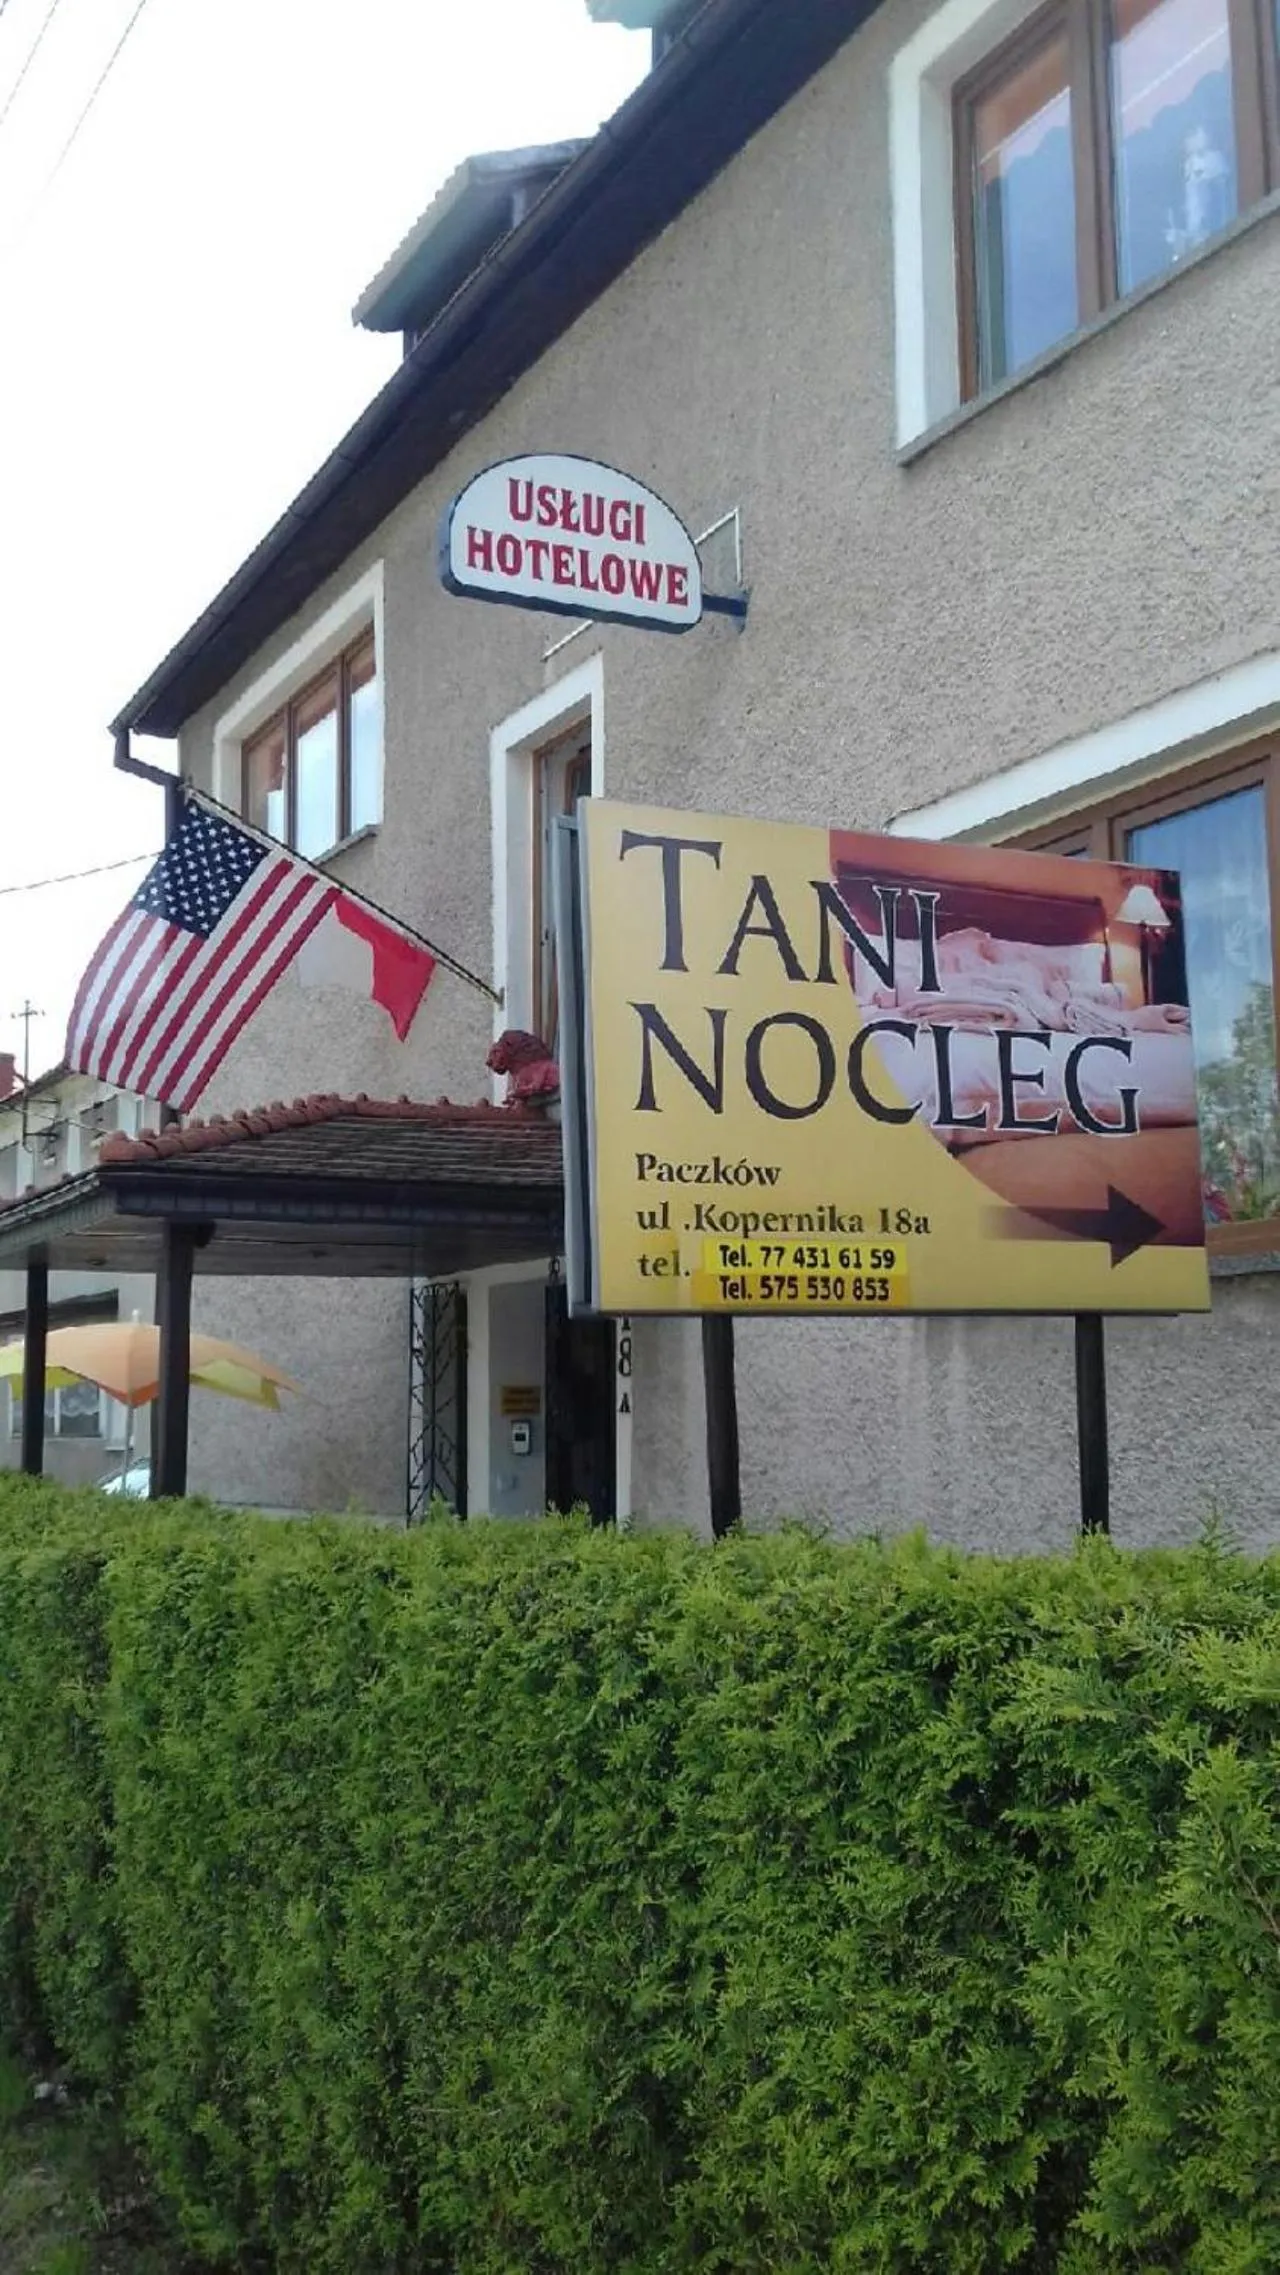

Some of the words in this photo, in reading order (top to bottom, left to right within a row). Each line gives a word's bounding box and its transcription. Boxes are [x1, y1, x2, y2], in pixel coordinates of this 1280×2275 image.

[508, 477, 646, 545] USŁUGI
[467, 525, 689, 607] HOTELOWE
[620, 829, 942, 992] TANI
[626, 1001, 1140, 1134] NOCLEG
[635, 1153, 781, 1186] Paczków
[879, 1207, 931, 1235] 18a
[637, 1249, 690, 1277] tel.
[719, 1244, 752, 1268] Tel.
[760, 1246, 785, 1268] 77
[793, 1247, 831, 1269] 431
[838, 1248, 863, 1269] 61
[870, 1249, 896, 1270] 59
[719, 1275, 752, 1300] Tel.
[760, 1275, 798, 1300] 575
[806, 1276, 845, 1300] 530
[852, 1277, 890, 1301] 853
